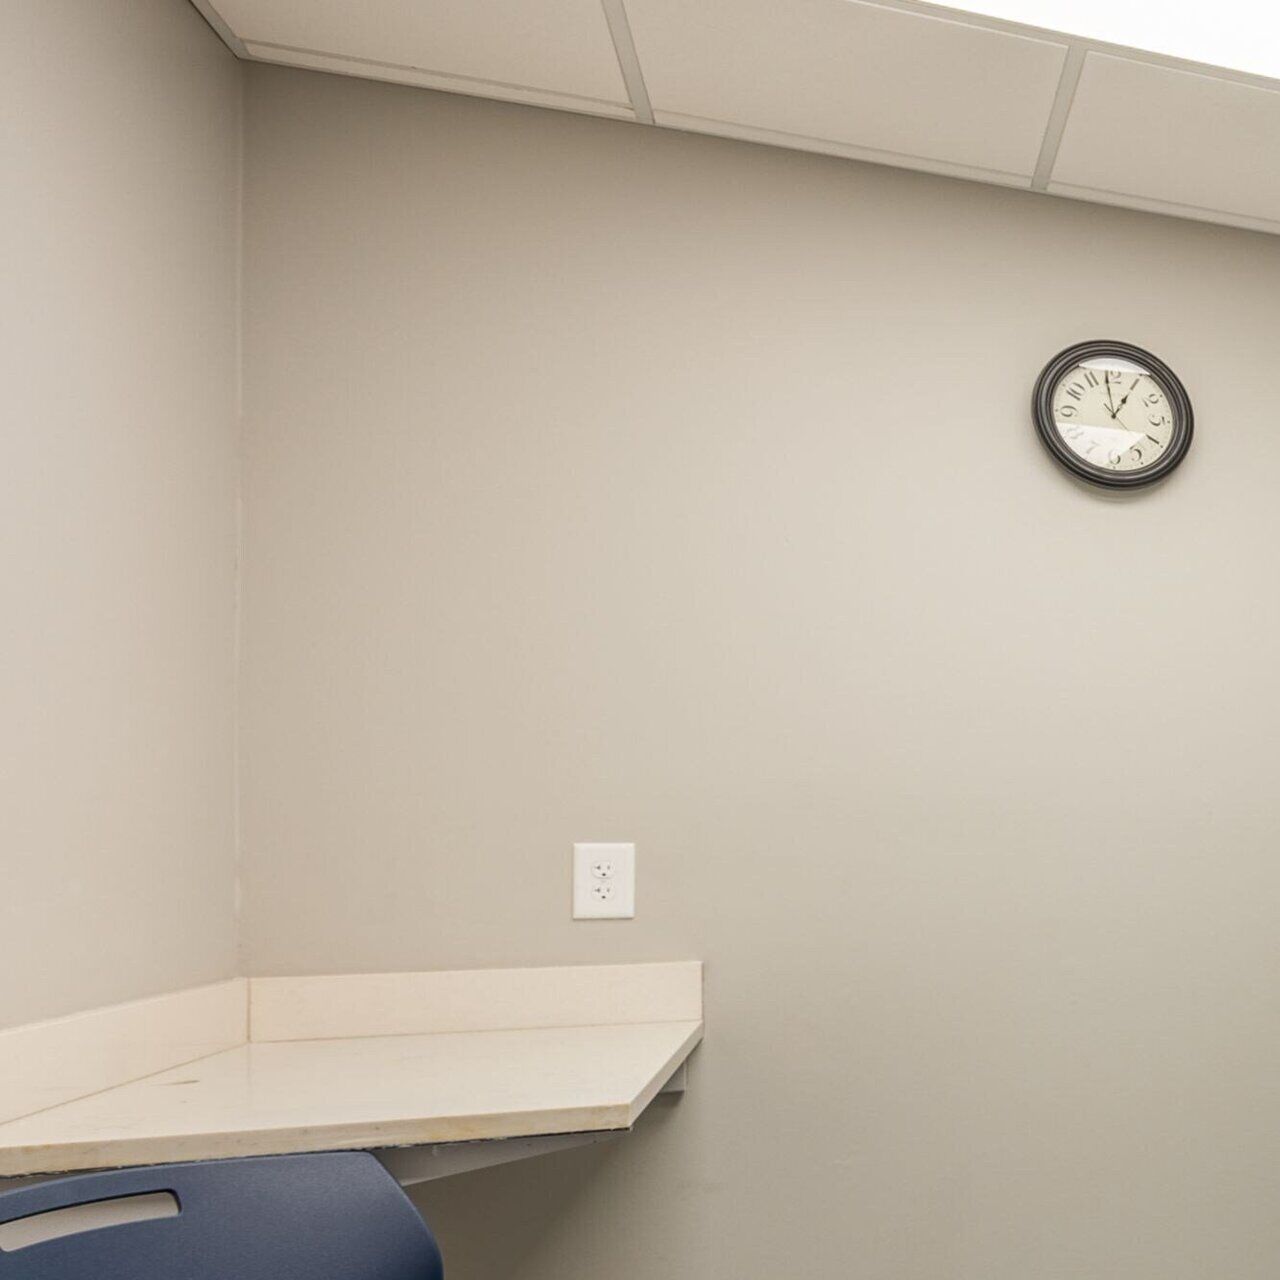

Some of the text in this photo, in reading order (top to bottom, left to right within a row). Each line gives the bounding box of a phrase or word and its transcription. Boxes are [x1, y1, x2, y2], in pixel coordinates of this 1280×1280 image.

[1083, 371, 1099, 388] 11
[1066, 382, 1086, 401] 10
[1143, 393, 1159, 407] 2
[1060, 405, 1077, 418] 9
[1148, 414, 1166, 427] 3
[1129, 445, 1142, 461] 5
